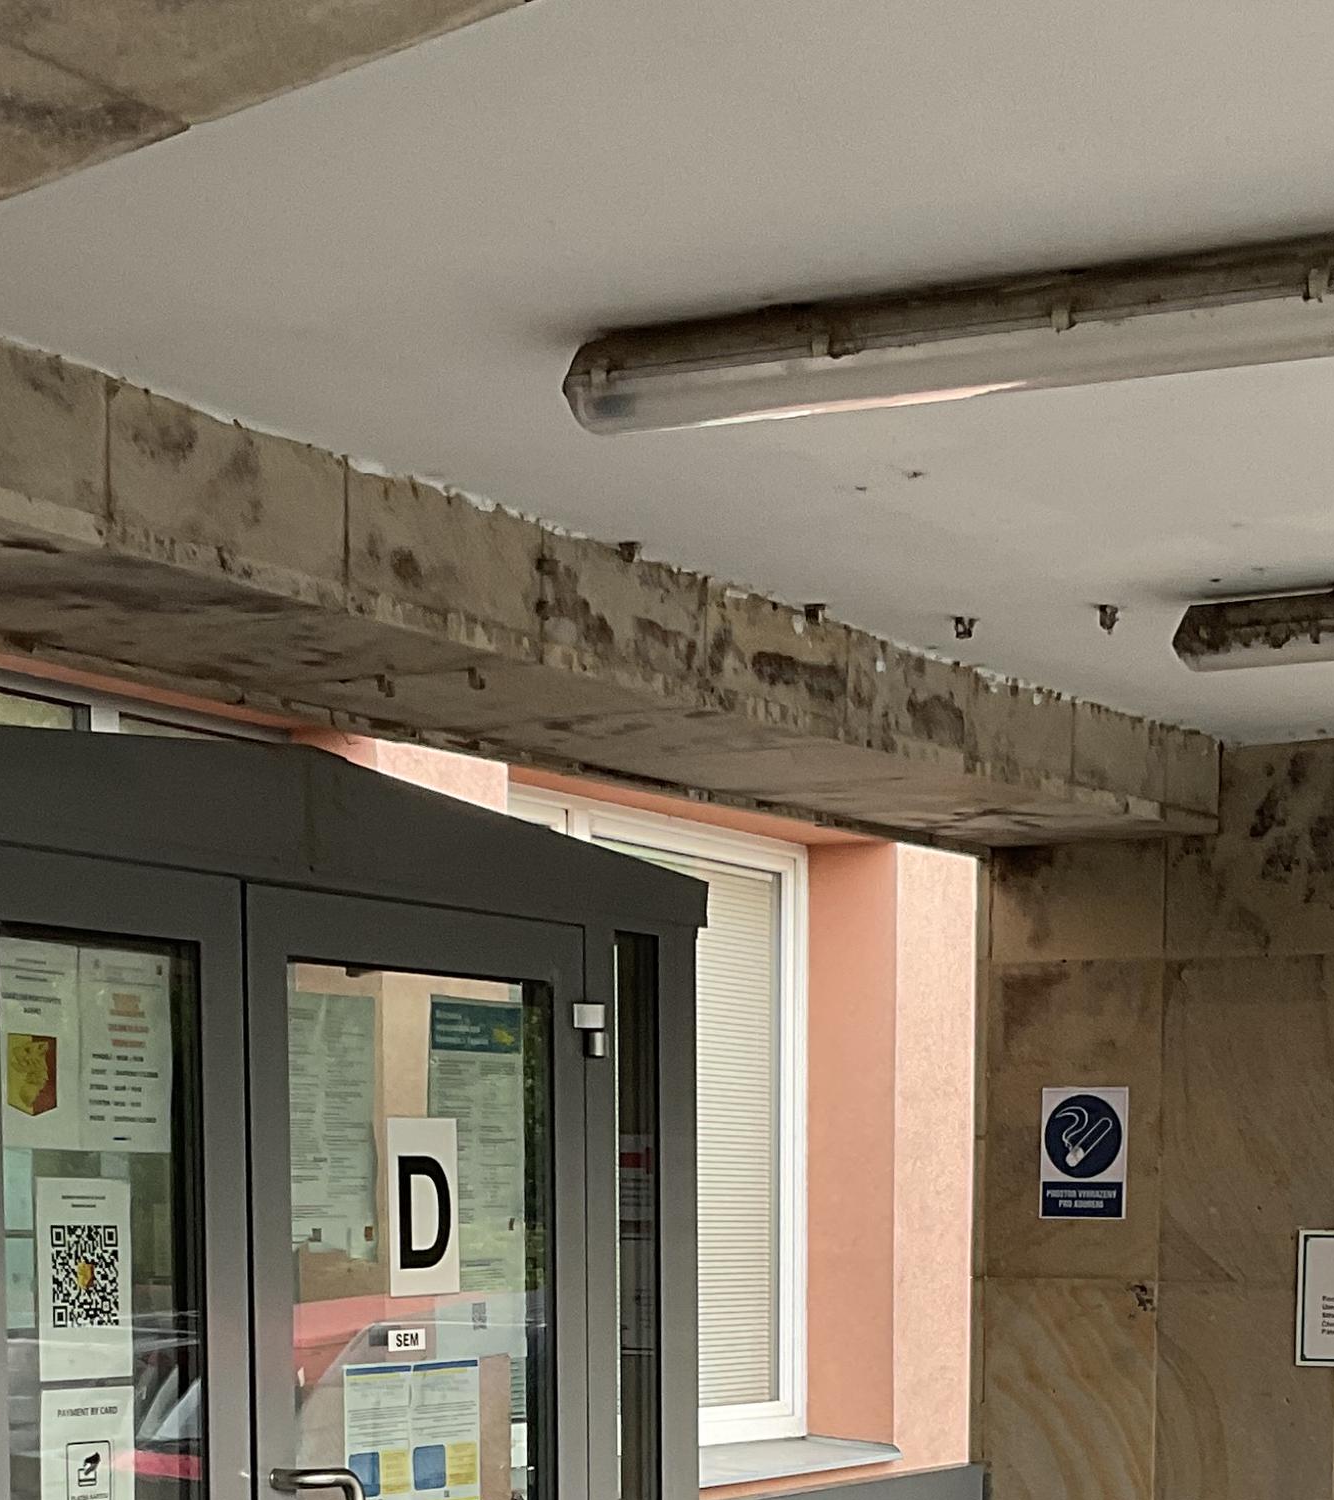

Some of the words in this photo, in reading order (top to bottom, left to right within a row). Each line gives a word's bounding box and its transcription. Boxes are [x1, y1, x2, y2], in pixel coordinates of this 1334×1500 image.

[398, 1155, 451, 1269] D
[396, 1332, 419, 1347] SEM
[57, 1407, 89, 1418] PAYMENT
[90, 1407, 99, 1416] BY
[100, 1406, 118, 1415] CARD
